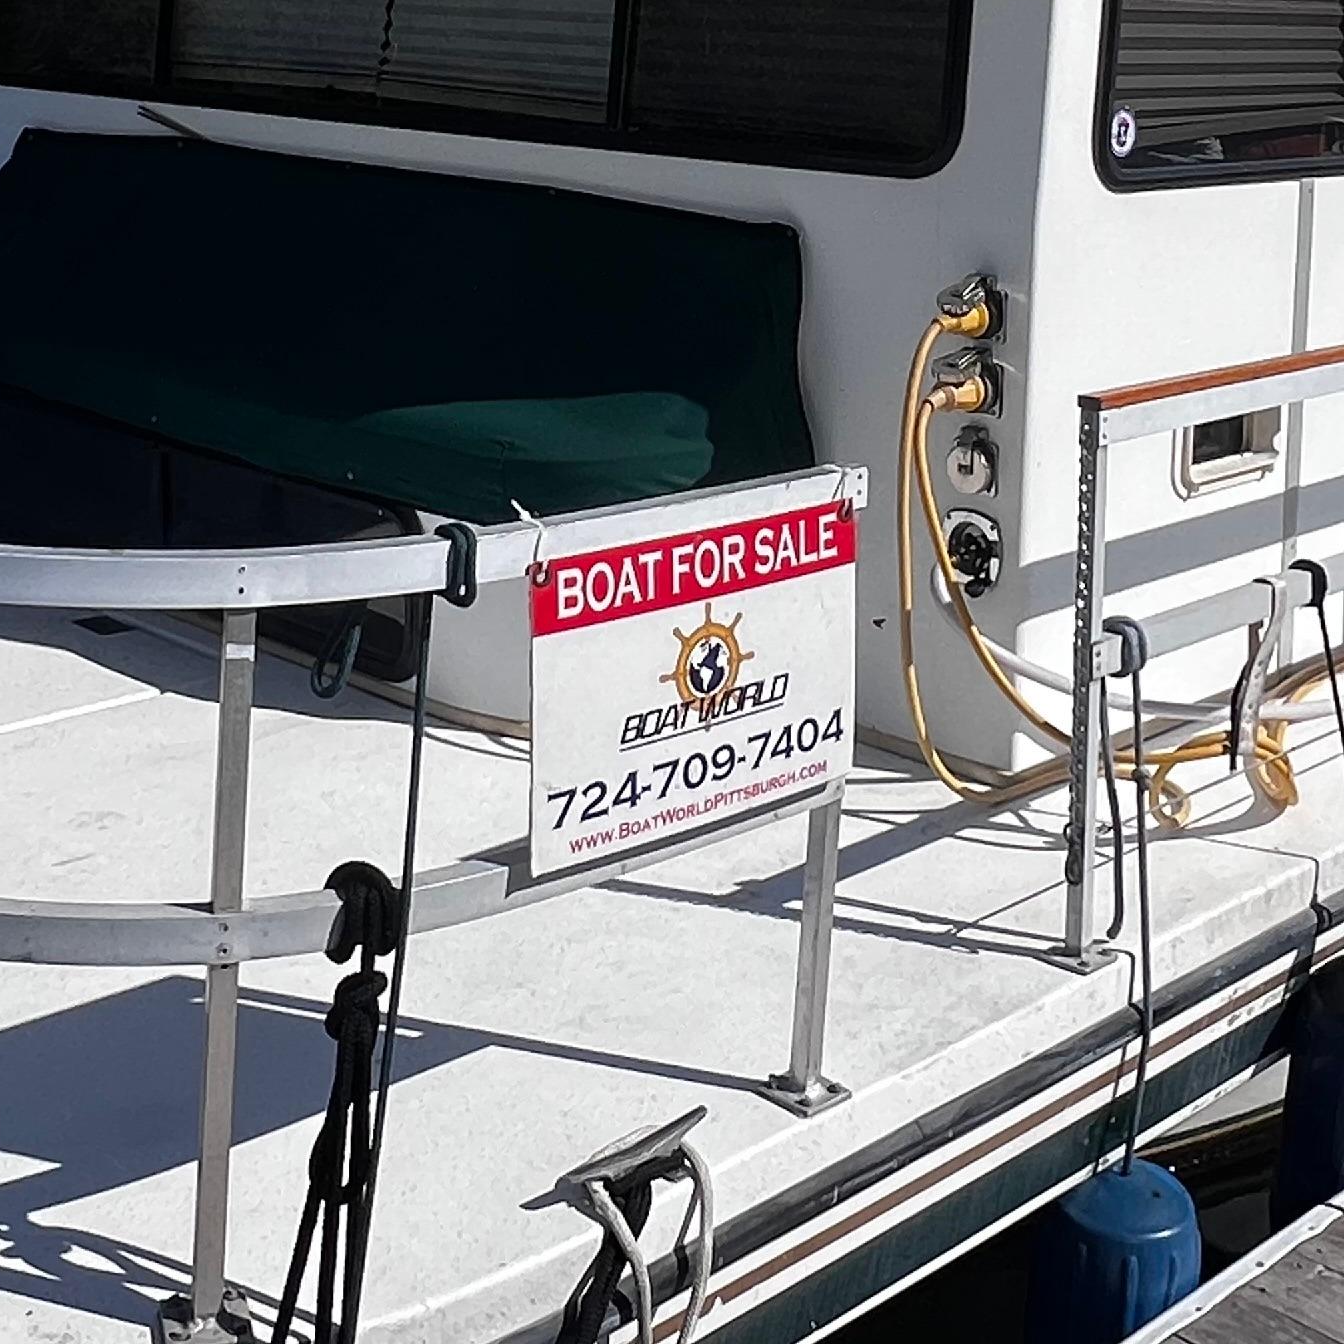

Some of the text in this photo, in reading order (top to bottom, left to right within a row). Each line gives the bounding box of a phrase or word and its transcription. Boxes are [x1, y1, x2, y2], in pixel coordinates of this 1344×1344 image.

[556, 512, 839, 619] BOAT FOR SALE
[620, 673, 789, 745] BOAT WORLD
[547, 707, 844, 831] 724-709-7404
